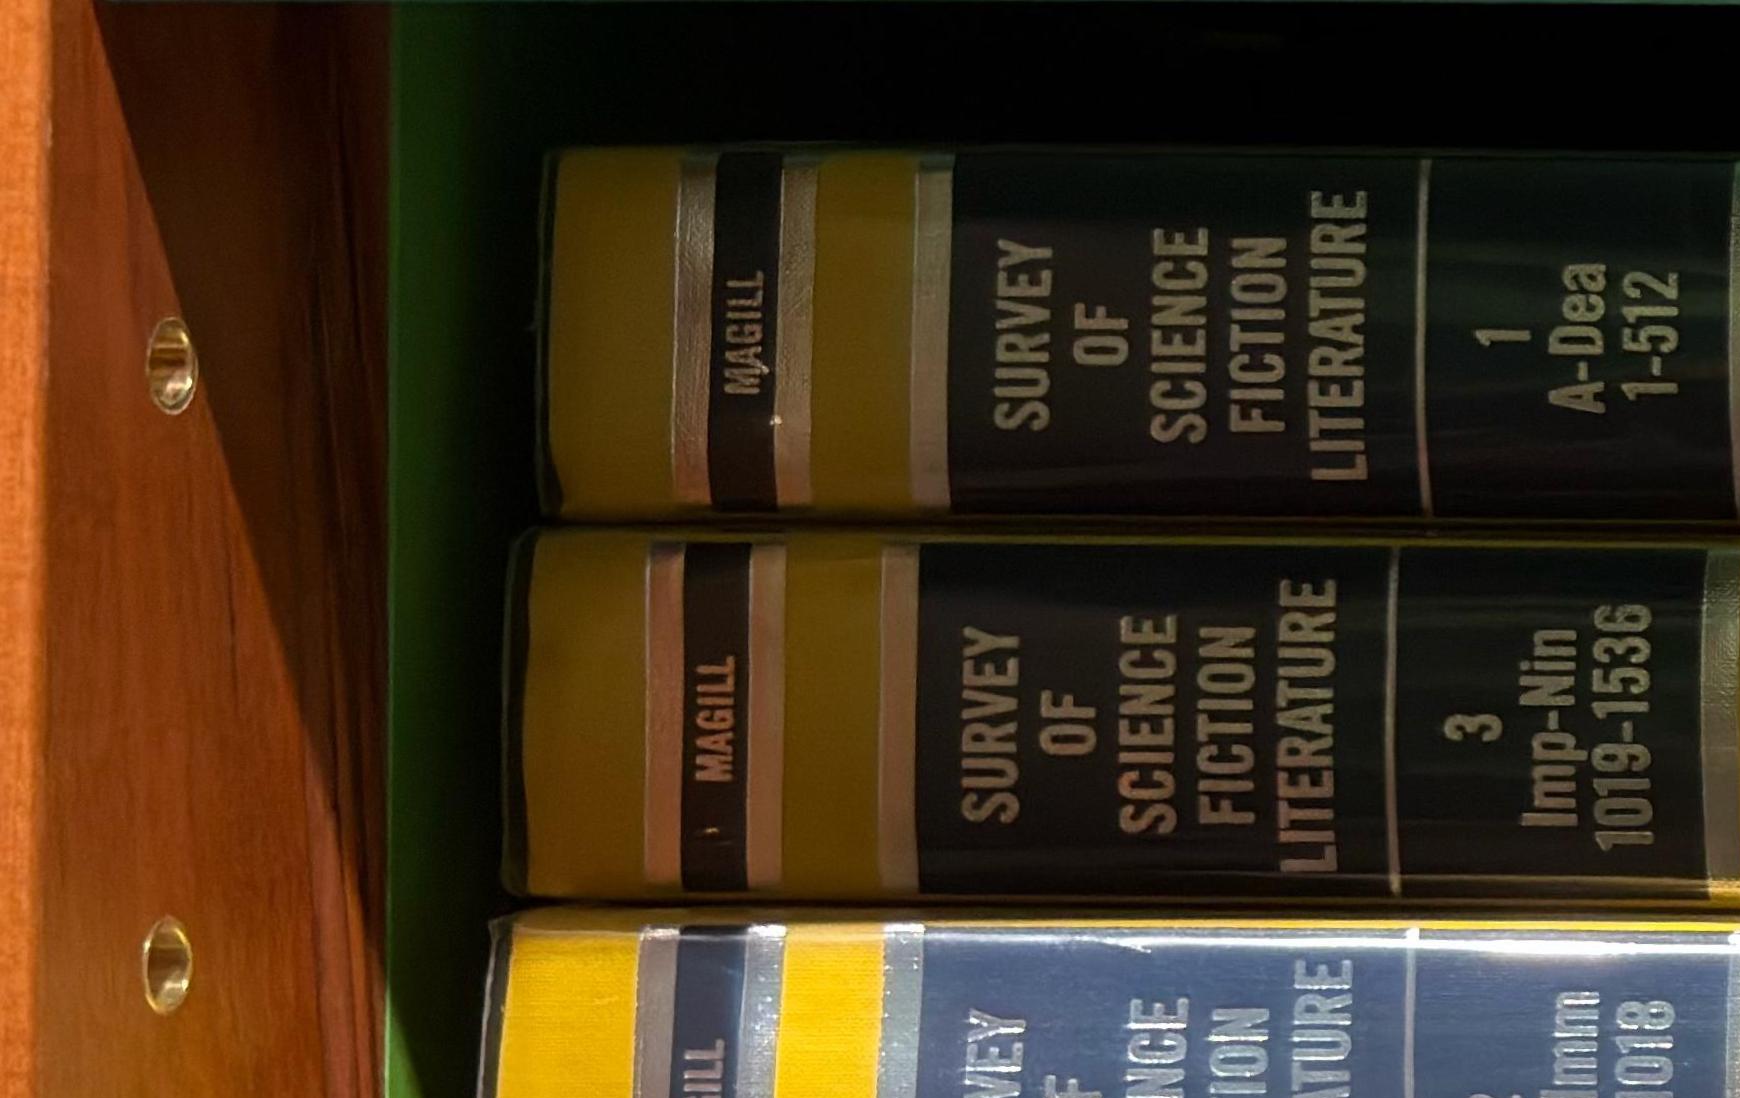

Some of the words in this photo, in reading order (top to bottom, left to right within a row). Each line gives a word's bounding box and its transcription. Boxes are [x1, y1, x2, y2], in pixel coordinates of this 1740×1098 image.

[721, 270, 766, 396] MAGILL
[994, 240, 1055, 432] SURVEY
[1074, 302, 1130, 368] OF
[1151, 226, 1209, 444] SCIENCE
[1230, 237, 1286, 434] FICTION
[1310, 189, 1367, 482] LITERATURE
[1475, 328, 1530, 348] 1
[1549, 262, 1606, 414] A-Dea
[1622, 270, 1680, 402] 1-512
[693, 654, 736, 782] MAGILL
[963, 626, 1020, 825] SURVEY
[1039, 689, 1096, 755] OF
[1121, 614, 1177, 836] SCIENCE
[1198, 624, 1257, 829] FICTION
[1278, 578, 1337, 875] LITERATURE
[1445, 712, 1501, 742] 3
[1520, 627, 1578, 828] Imp-Nin
[1594, 603, 1654, 852] 1019-1536
